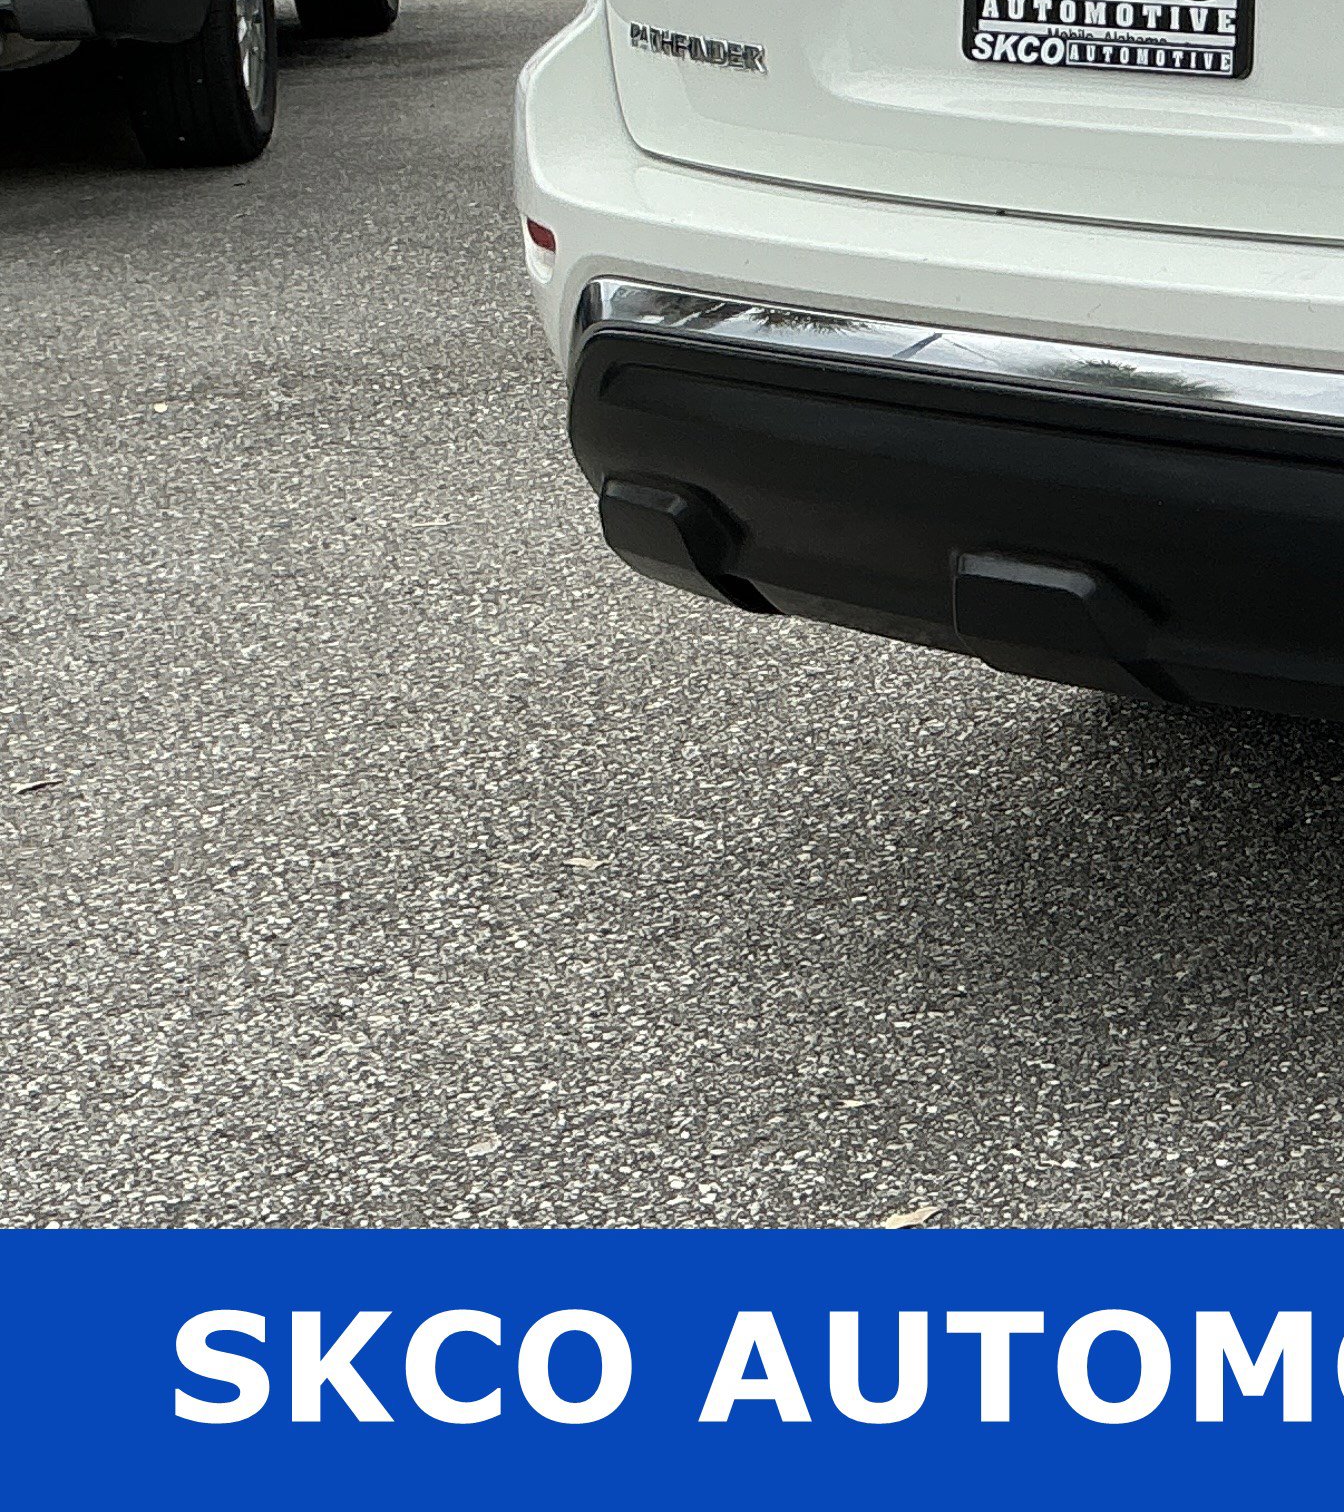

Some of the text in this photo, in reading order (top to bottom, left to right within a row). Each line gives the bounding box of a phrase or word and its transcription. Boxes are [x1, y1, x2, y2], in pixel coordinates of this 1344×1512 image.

[630, 22, 768, 75] PATHFINDER
[971, 32, 1232, 71] SKCO AUTOMOTIVE
